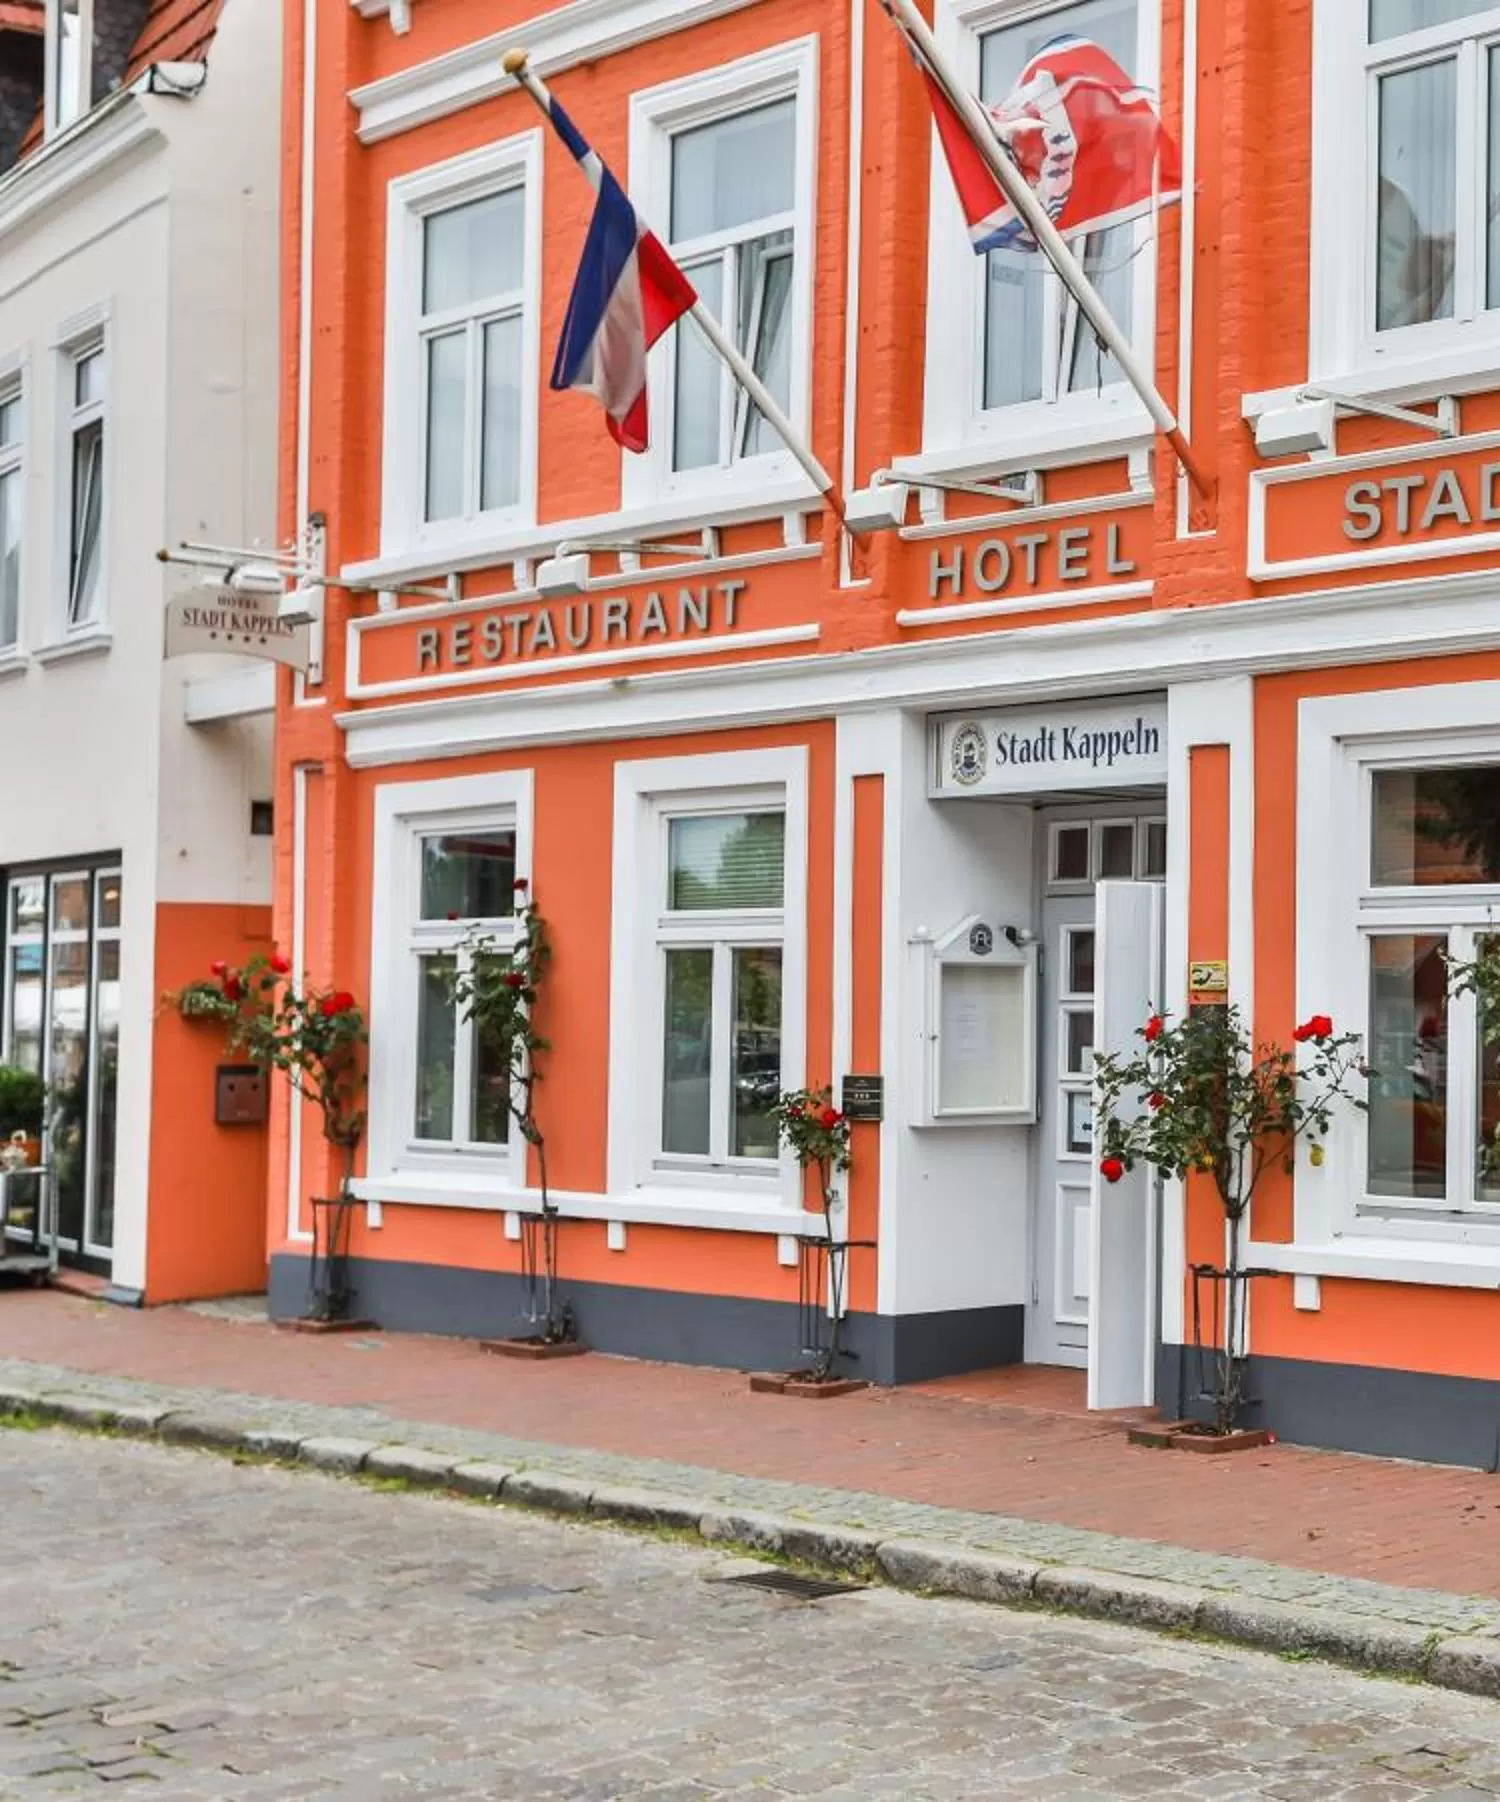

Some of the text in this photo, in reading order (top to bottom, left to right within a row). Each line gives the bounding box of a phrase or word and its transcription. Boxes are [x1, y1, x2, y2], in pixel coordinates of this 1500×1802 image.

[928, 521, 1136, 598] HOTEL
[183, 607, 227, 629] STADT
[416, 580, 747, 671] RESTAURANT
[995, 726, 1057, 765] Stadt
[1063, 717, 1160, 768] Kappeln
